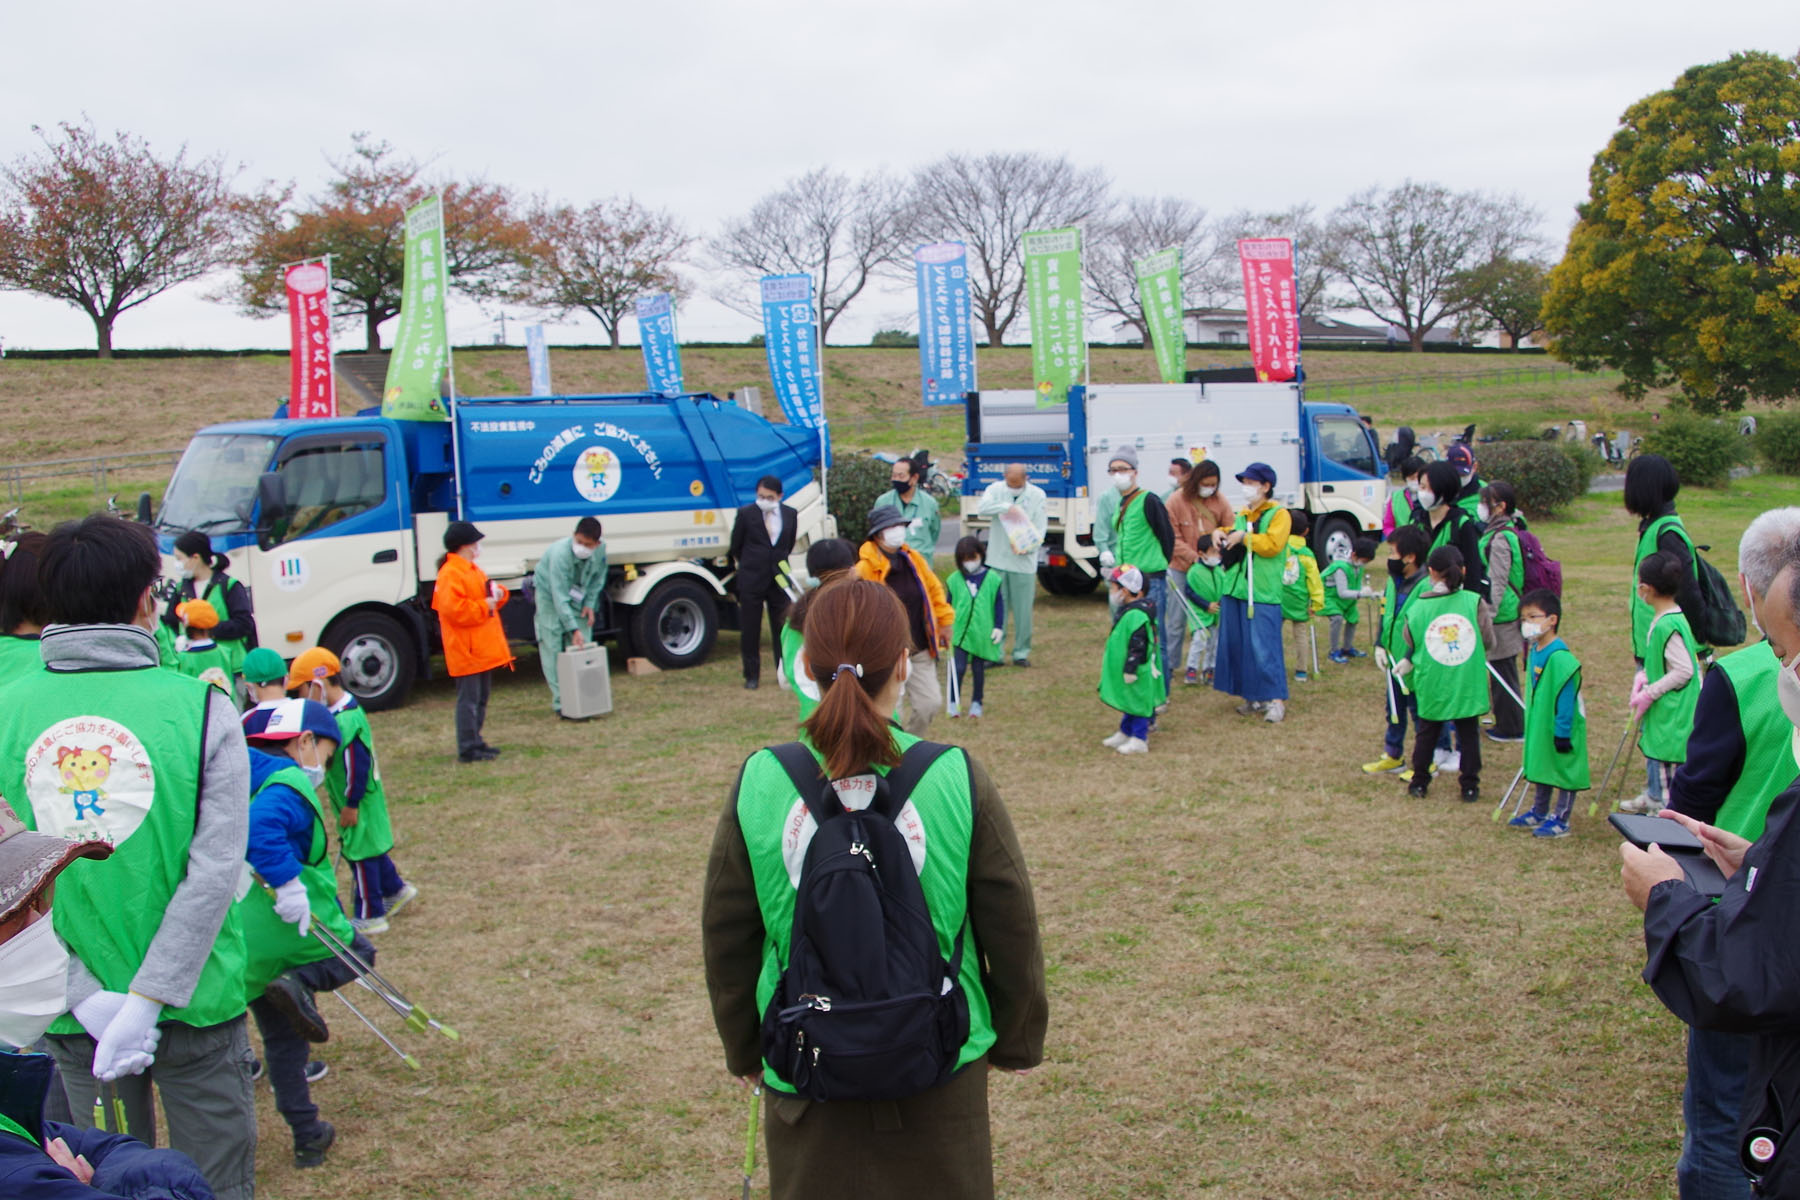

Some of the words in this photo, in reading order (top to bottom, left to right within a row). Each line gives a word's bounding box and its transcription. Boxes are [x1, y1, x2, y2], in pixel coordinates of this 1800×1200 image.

[528, 424, 587, 485] ごみの減量に
[900, 809, 921, 843] します
